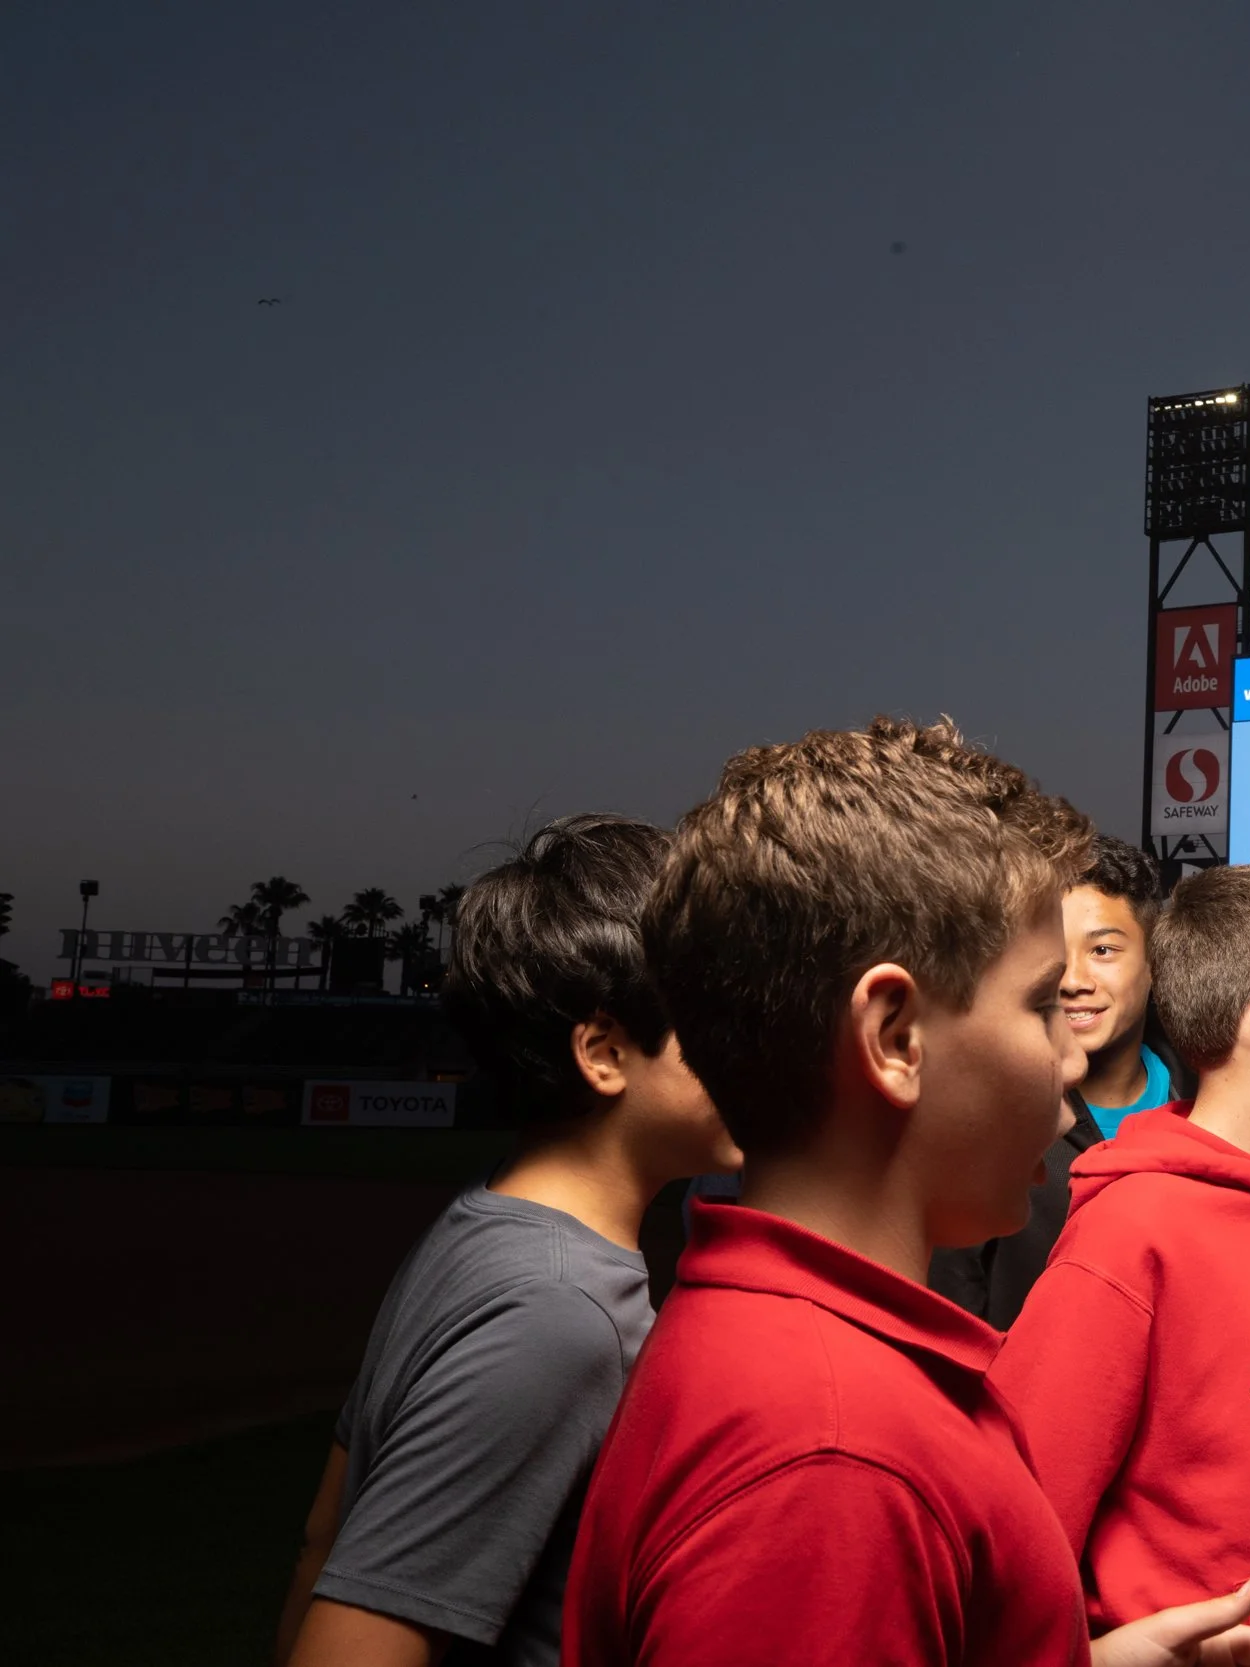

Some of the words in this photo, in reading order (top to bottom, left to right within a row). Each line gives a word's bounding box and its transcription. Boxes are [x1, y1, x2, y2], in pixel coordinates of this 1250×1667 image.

[1174, 675, 1218, 694] Adobe
[1164, 805, 1218, 819] SAFEWAY
[359, 1095, 448, 1113] TOYOTA
